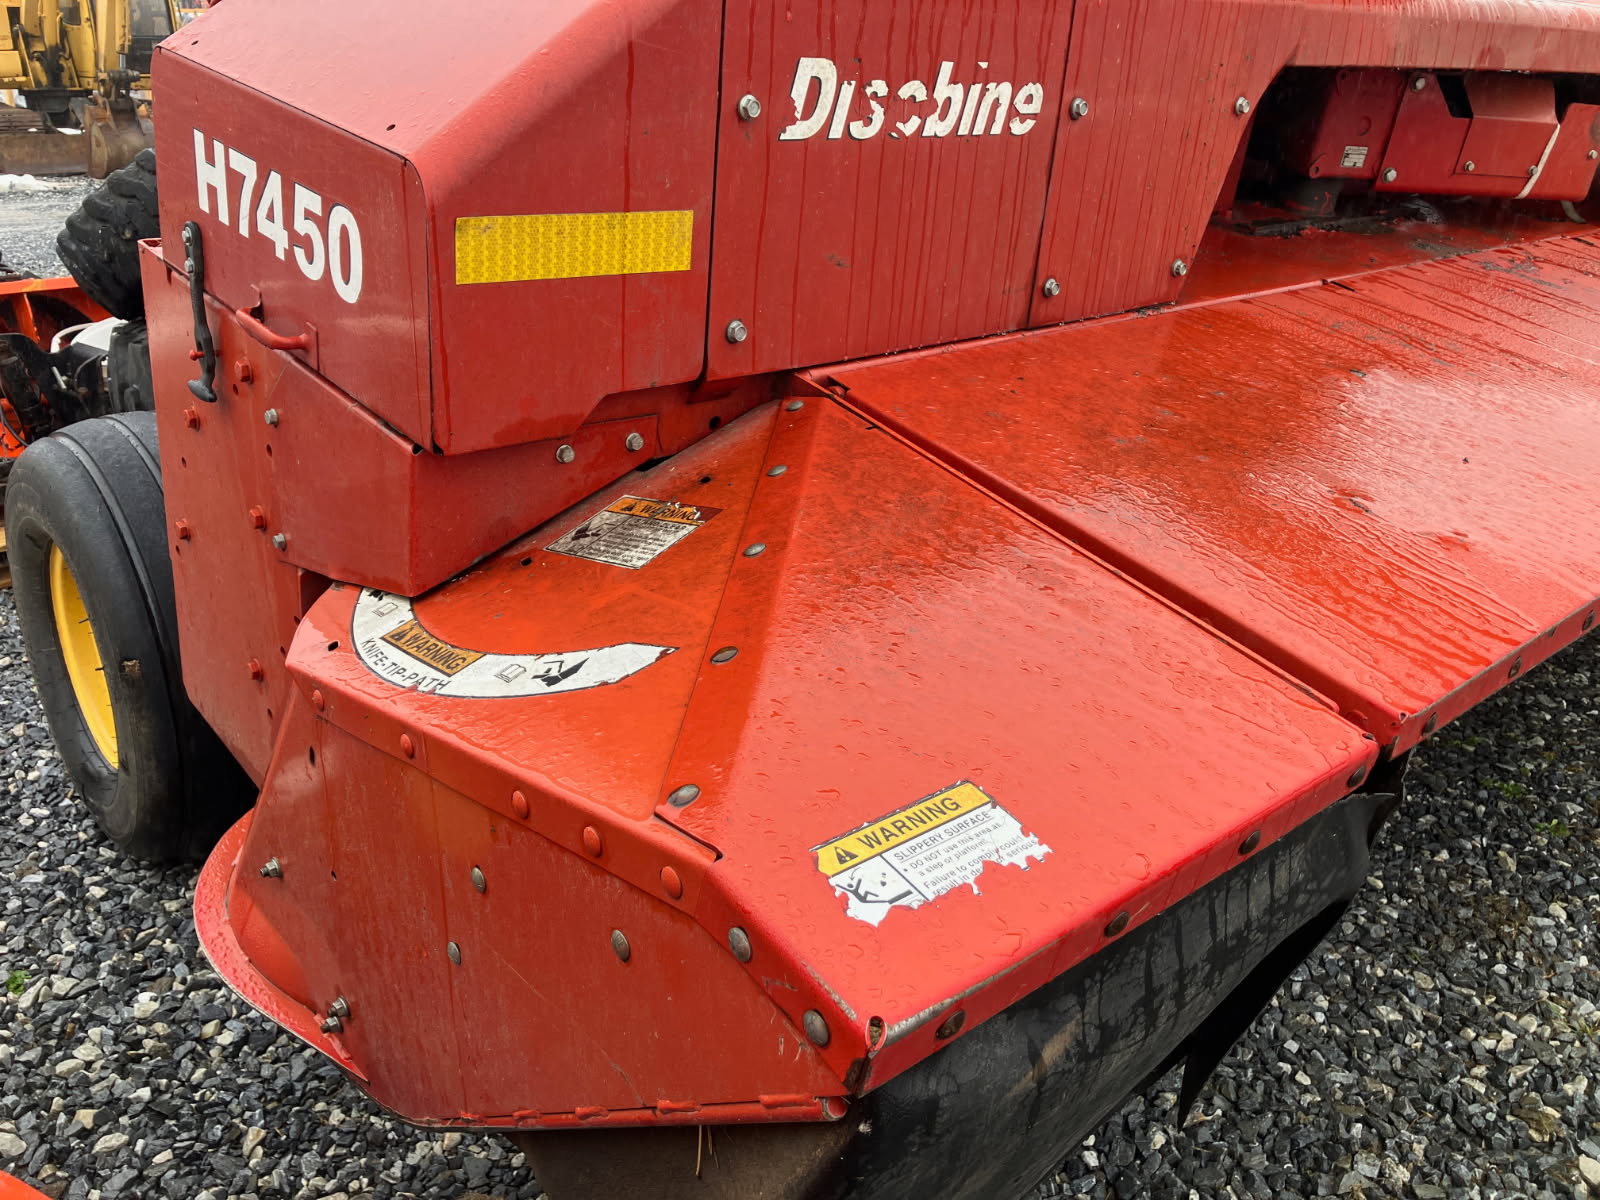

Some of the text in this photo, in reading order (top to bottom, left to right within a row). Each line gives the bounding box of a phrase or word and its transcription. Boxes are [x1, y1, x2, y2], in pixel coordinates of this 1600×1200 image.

[778, 57, 1044, 140] Discbine
[193, 127, 362, 303] H7450
[403, 632, 468, 671] WARNING
[856, 797, 962, 850] WARNING
[894, 810, 992, 861] SLIPPERY SURFACE
[910, 858, 924, 870] DO
[924, 849, 942, 862] NOT
[944, 843, 958, 854] use
[957, 833, 974, 847] this
[974, 826, 991, 839] area
[923, 869, 957, 889] Failure
[958, 864, 967, 875] to
[999, 835, 1024, 851] could
[925, 863, 944, 875] step
[944, 856, 953, 864] or
[960, 873, 970, 883] in
[1006, 840, 1038, 858] serious
